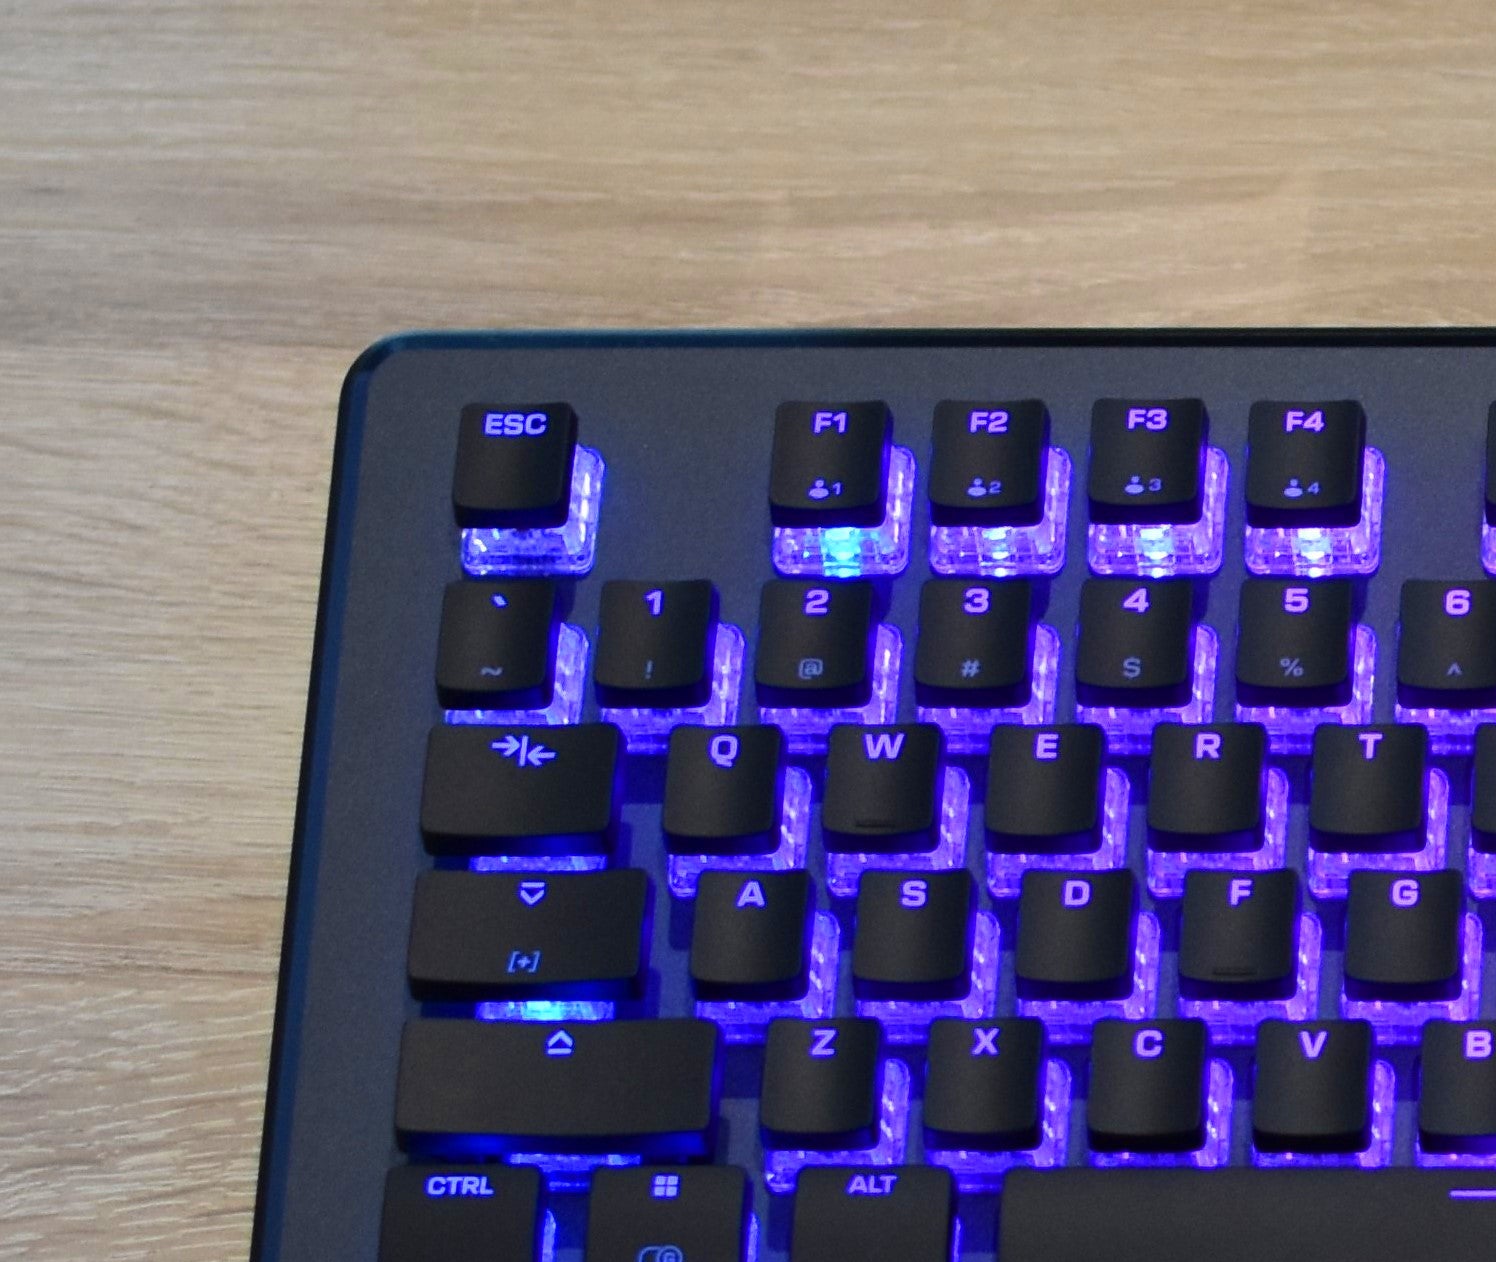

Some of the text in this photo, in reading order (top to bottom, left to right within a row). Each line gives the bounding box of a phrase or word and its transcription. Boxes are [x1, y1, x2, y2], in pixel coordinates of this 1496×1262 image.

[484, 413, 547, 436] ESC
[814, 412, 847, 434] F1
[969, 411, 1008, 433] F2
[1127, 408, 1168, 430] F3
[1285, 410, 1325, 432] F4
[832, 481, 841, 495] 1
[988, 480, 1002, 494] 2
[1148, 477, 1162, 492] 3
[1307, 481, 1320, 495] 4
[646, 590, 662, 615] 1
[804, 589, 829, 614] 2
[963, 587, 989, 614] 3
[1122, 588, 1149, 613] 4
[1284, 587, 1309, 613] 5
[1445, 589, 1471, 615] 6
[710, 734, 738, 768] Q
[864, 733, 905, 759] W
[1035, 733, 1059, 759] E
[1195, 732, 1221, 759] R
[1358, 732, 1383, 760] T
[736, 880, 765, 907] A
[900, 880, 927, 907] S
[1063, 880, 1090, 906] D
[1229, 879, 1252, 906] F
[1391, 879, 1419, 907] G
[810, 1029, 836, 1056] Z
[971, 1027, 999, 1055] X
[1134, 1029, 1163, 1058] C
[1299, 1030, 1327, 1059] V
[1465, 1030, 1492, 1058] B
[427, 1175, 494, 1196] CTRL
[847, 1175, 898, 1194] ALT
